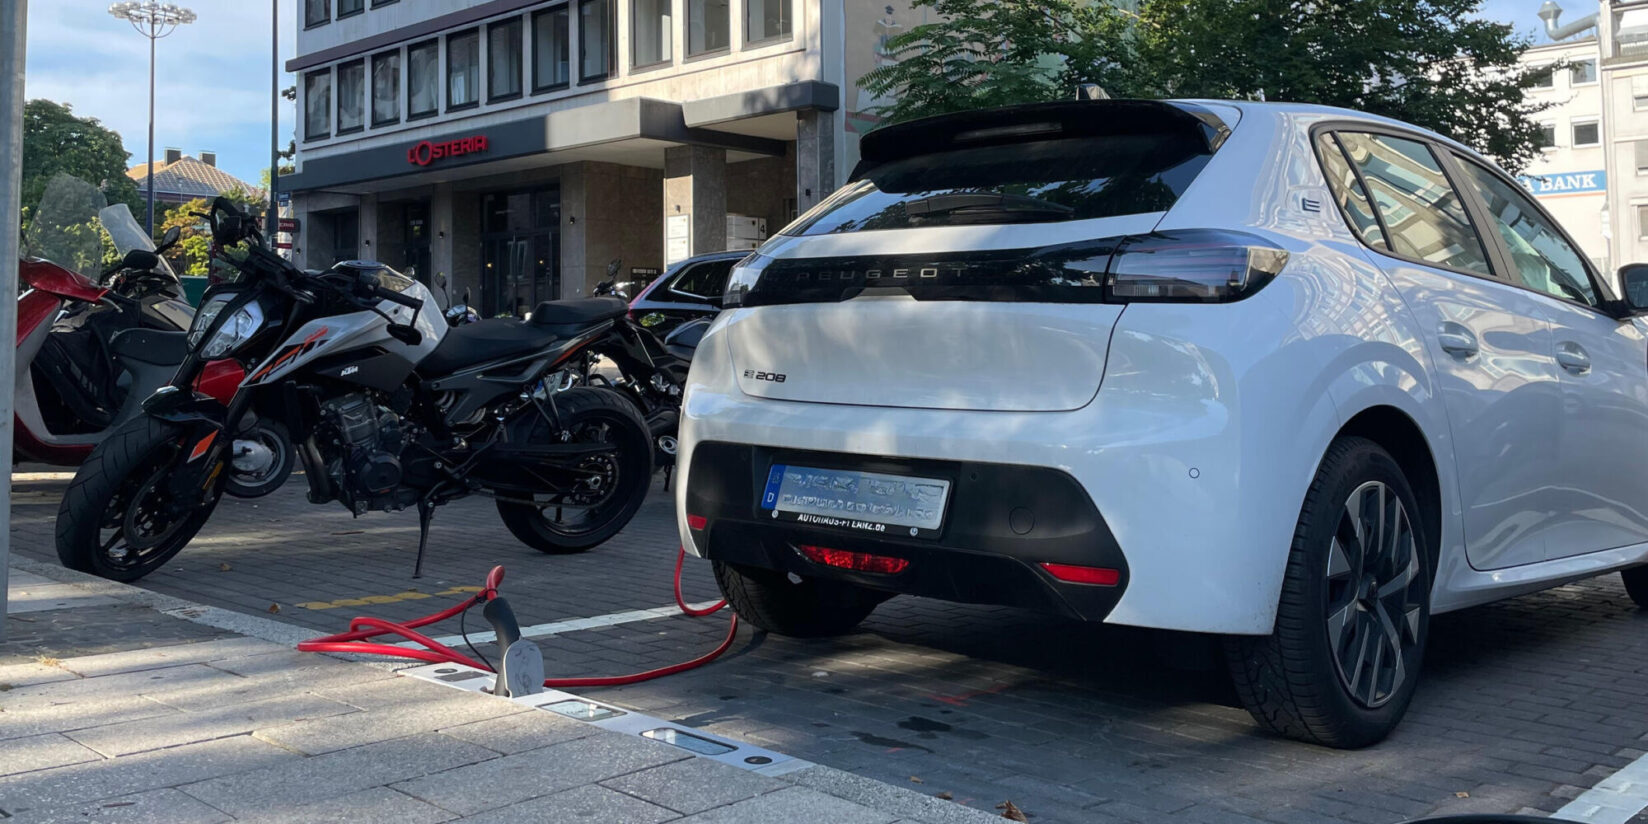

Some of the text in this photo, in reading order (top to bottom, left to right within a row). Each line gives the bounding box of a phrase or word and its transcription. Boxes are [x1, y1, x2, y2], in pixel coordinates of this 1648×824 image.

[1540, 173, 1597, 193] BANK
[796, 267, 967, 282] PEUGEOT
[756, 371, 787, 383] 208
